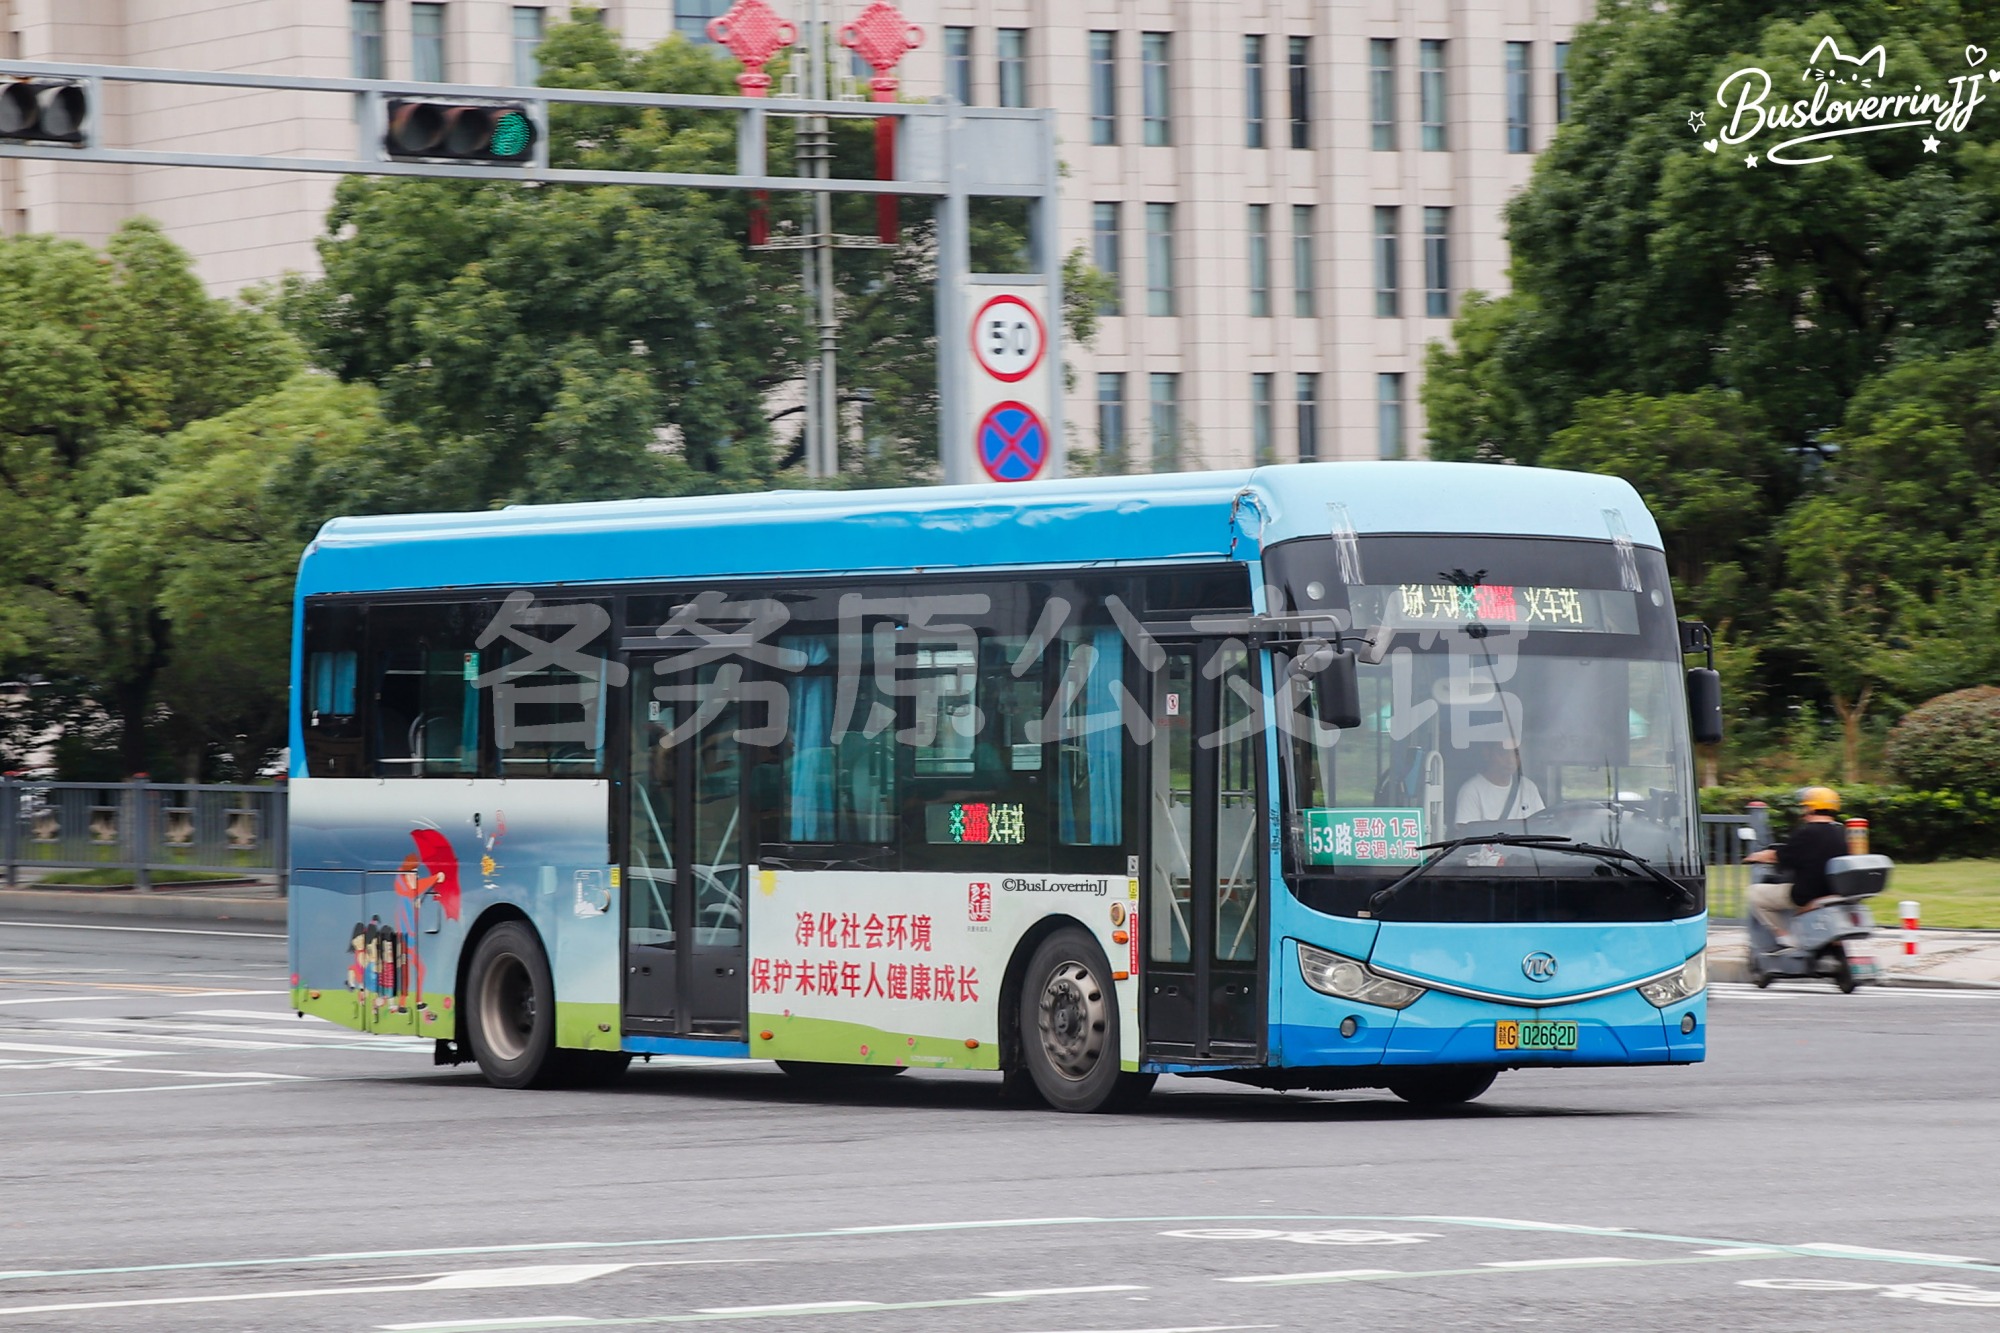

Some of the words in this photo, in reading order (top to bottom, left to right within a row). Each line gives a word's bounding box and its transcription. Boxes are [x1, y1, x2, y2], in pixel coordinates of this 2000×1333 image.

[987, 320, 1032, 356] 50
[1523, 586, 1583, 624] 火车站
[1312, 823, 1353, 856] 53路
[1353, 817, 1419, 838] 票价1元
[795, 911, 932, 951] 净化社会环境
[751, 958, 979, 1002] 保护未成年人健康成长
